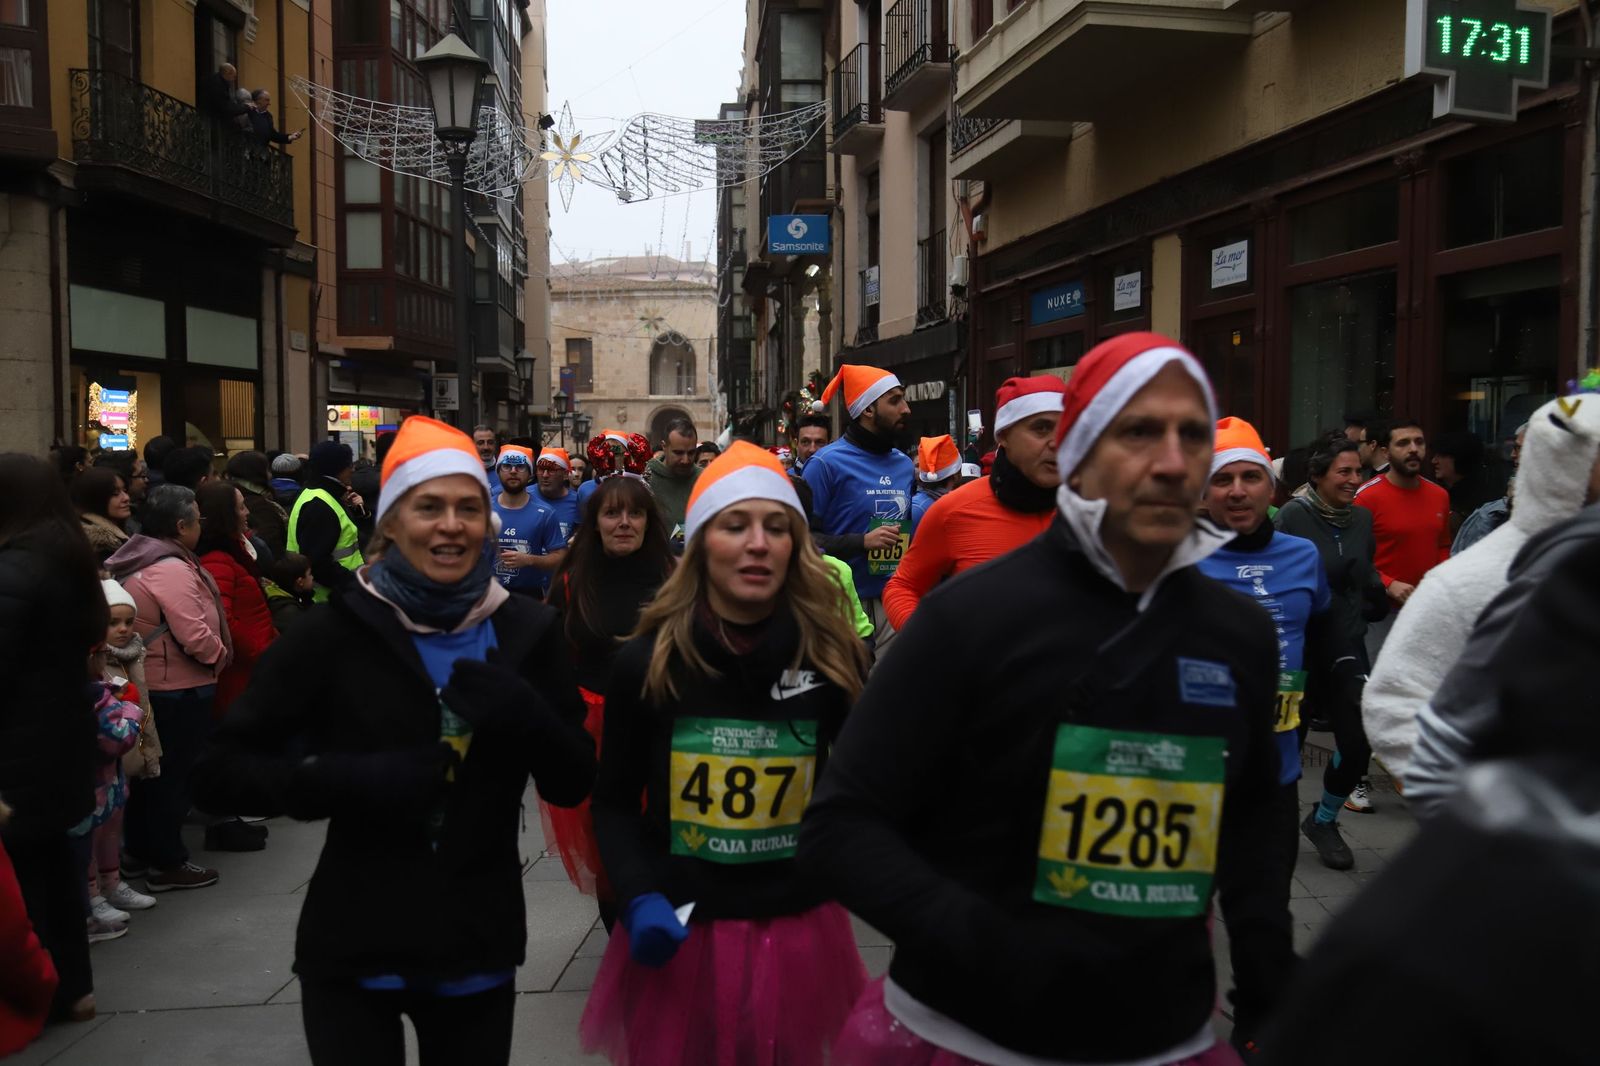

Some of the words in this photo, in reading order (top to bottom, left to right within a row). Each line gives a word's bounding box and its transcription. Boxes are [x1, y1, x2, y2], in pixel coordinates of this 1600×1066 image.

[1436, 15, 1530, 64] 17:31
[772, 242, 825, 251] Samsonite
[1047, 293, 1072, 309] NUXE
[879, 476, 892, 486] 46
[504, 528, 516, 536] 46
[780, 669, 816, 687] NIKE
[712, 736, 740, 748] CAJA
[680, 762, 797, 819] 487
[1060, 794, 1196, 869] 1285
[708, 838, 747, 854] CAJA
[751, 834, 797, 852] RURAL
[1090, 881, 1141, 903] CAJA
[1146, 884, 1199, 903] RURAL
